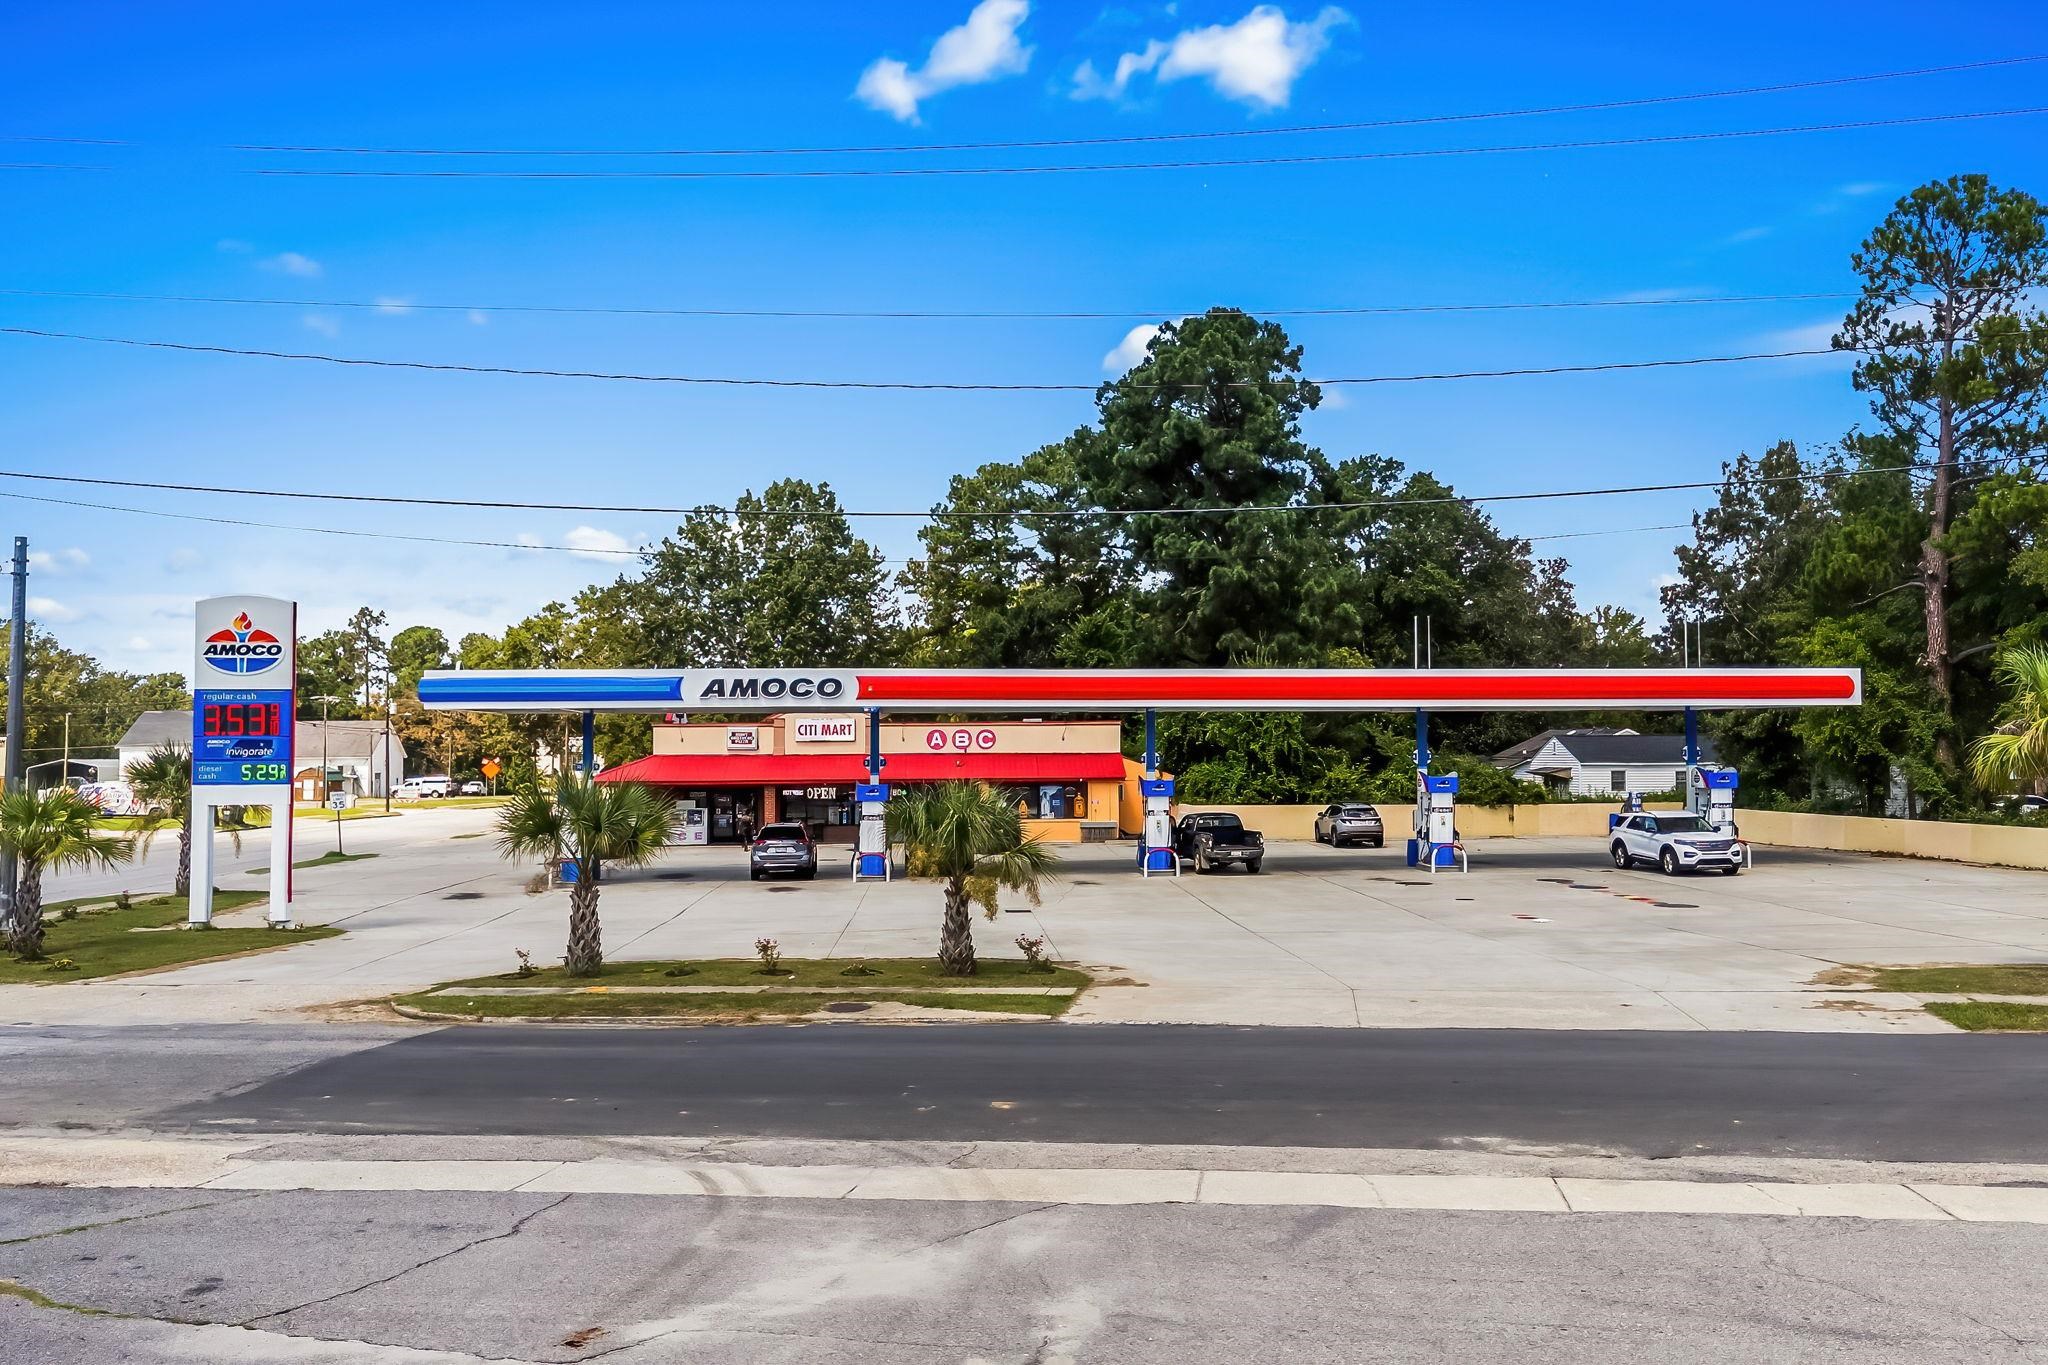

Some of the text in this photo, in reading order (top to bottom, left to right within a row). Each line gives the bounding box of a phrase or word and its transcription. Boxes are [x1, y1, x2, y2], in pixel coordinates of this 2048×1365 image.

[203, 644, 283, 656] AMOCO
[700, 678, 843, 698] AMOCO
[204, 704, 266, 736] 3.53
[797, 724, 853, 736] CITI MART
[225, 748, 273, 758] Invigorate
[241, 764, 278, 781] 5.29
[806, 788, 836, 799] OPEN
[332, 801, 345, 809] 35
